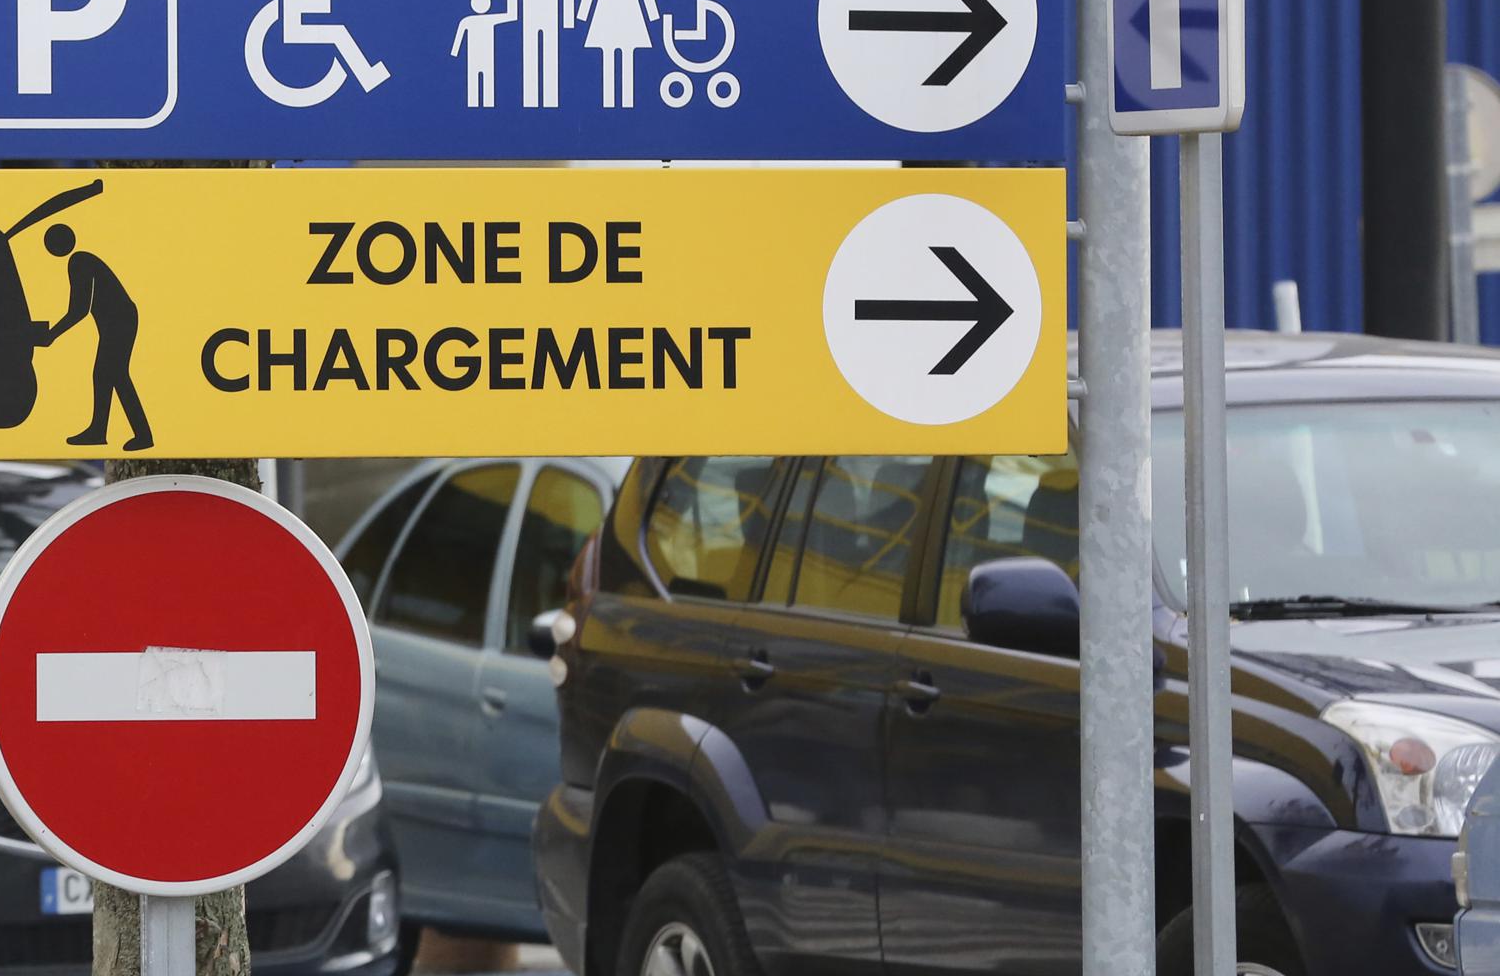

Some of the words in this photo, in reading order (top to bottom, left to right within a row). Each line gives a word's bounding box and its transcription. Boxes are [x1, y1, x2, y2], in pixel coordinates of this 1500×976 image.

[307, 221, 522, 285] ZONE
[548, 221, 643, 284] DE
[201, 326, 751, 392] CHARGEMENT
